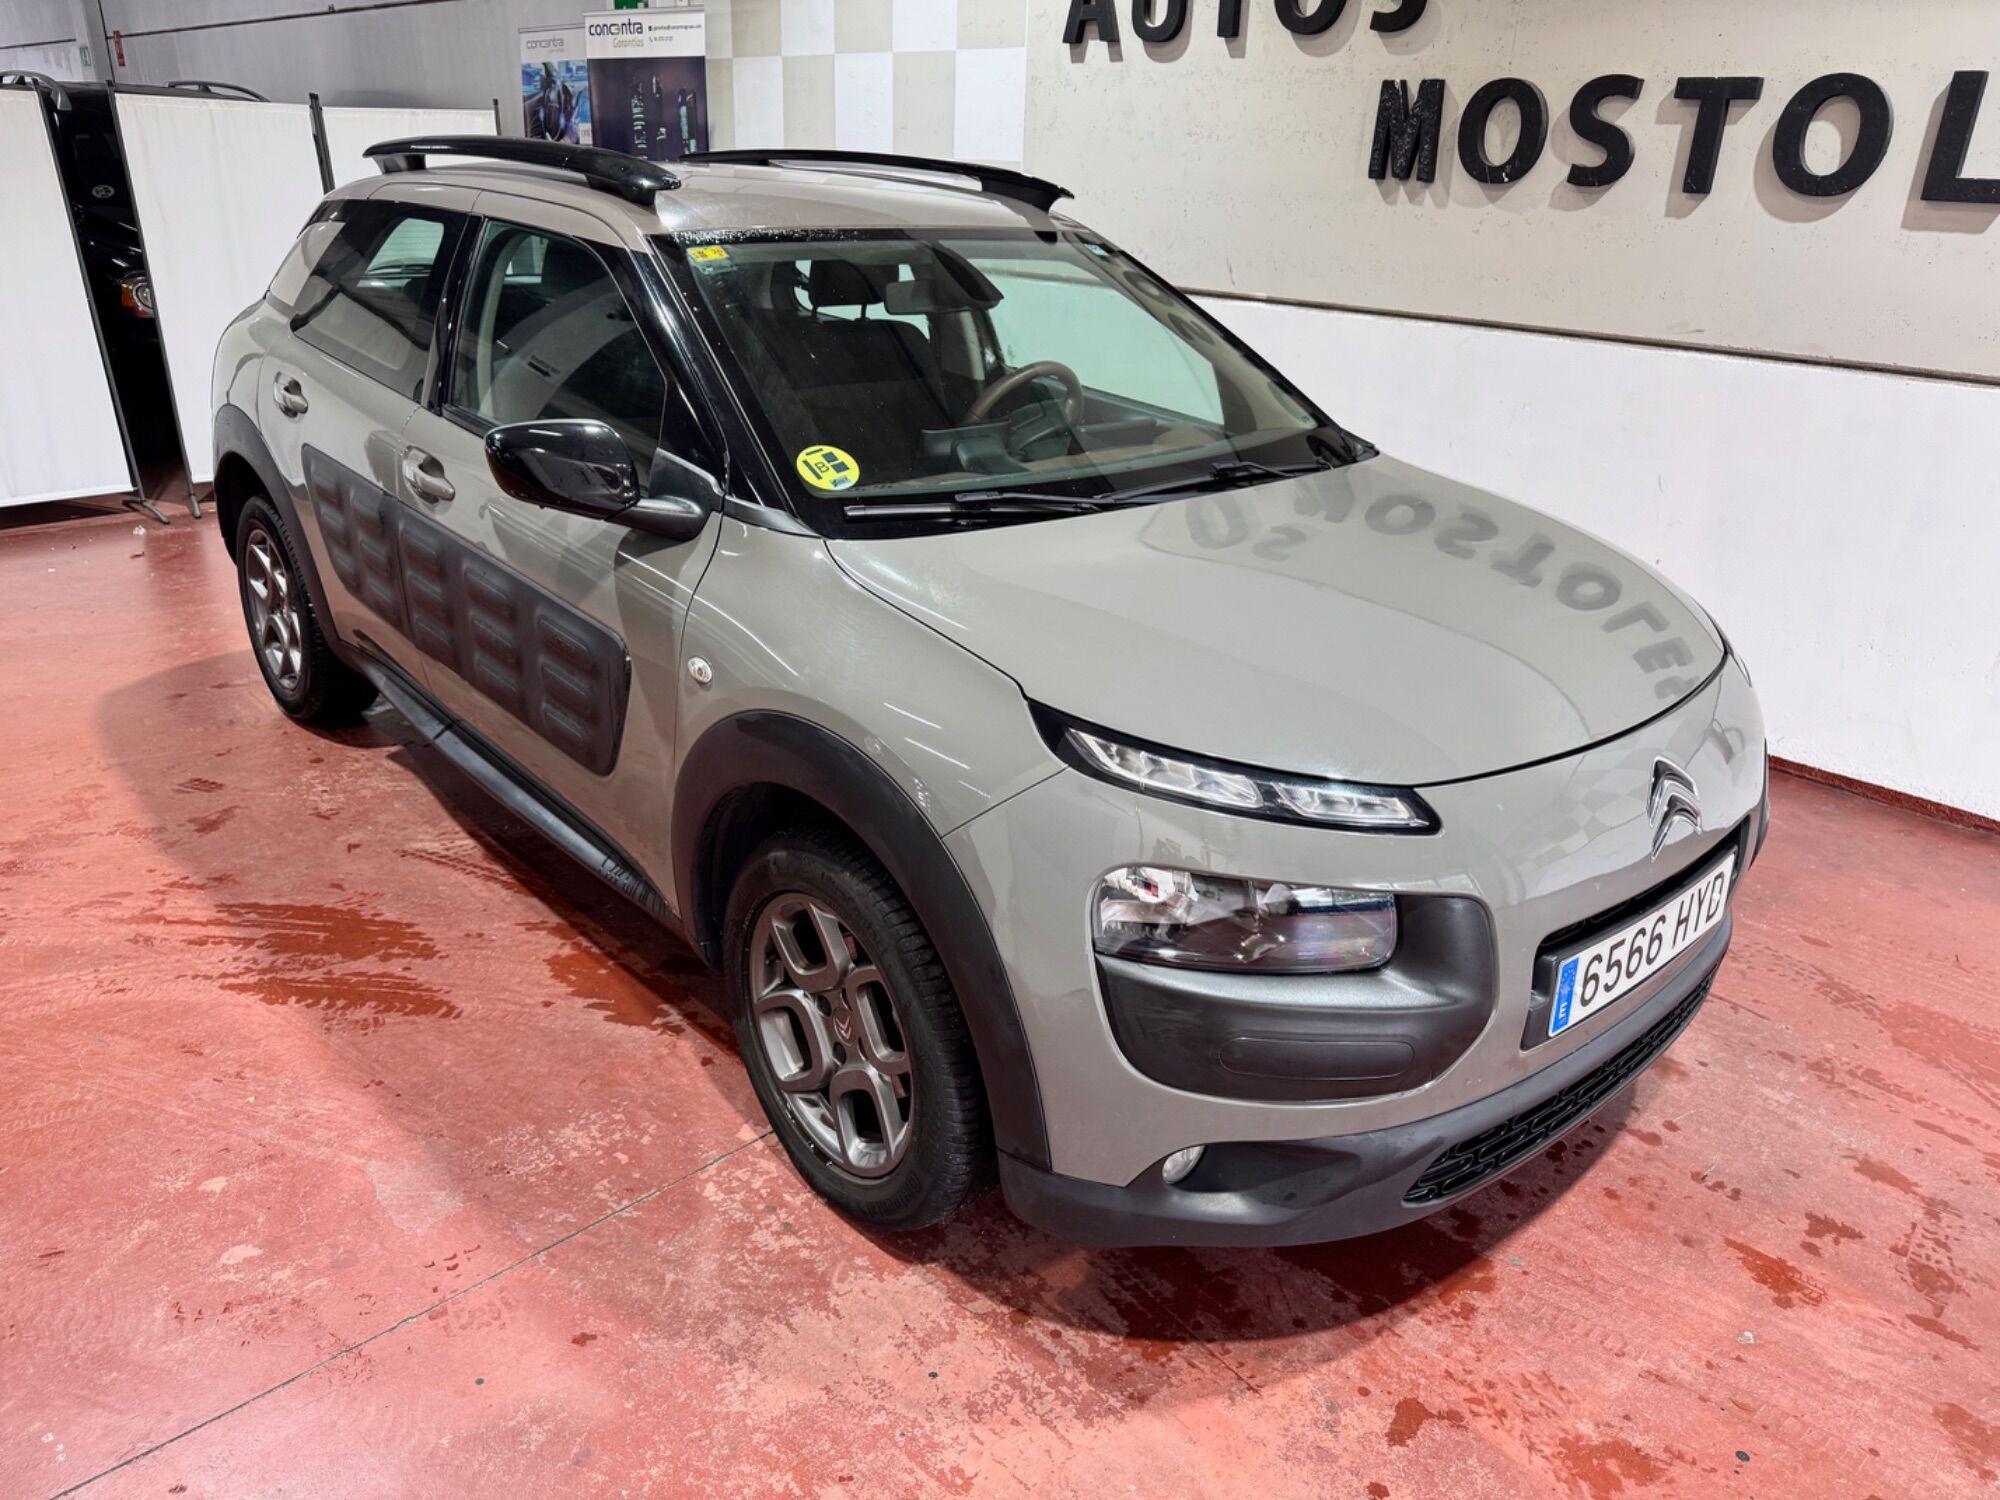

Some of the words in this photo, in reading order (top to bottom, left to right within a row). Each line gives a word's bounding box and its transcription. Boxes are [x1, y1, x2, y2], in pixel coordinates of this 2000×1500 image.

[588, 18, 643, 36] concentra
[1369, 70, 2000, 204] MOSTOL
[1580, 914, 1666, 1008] 6566
